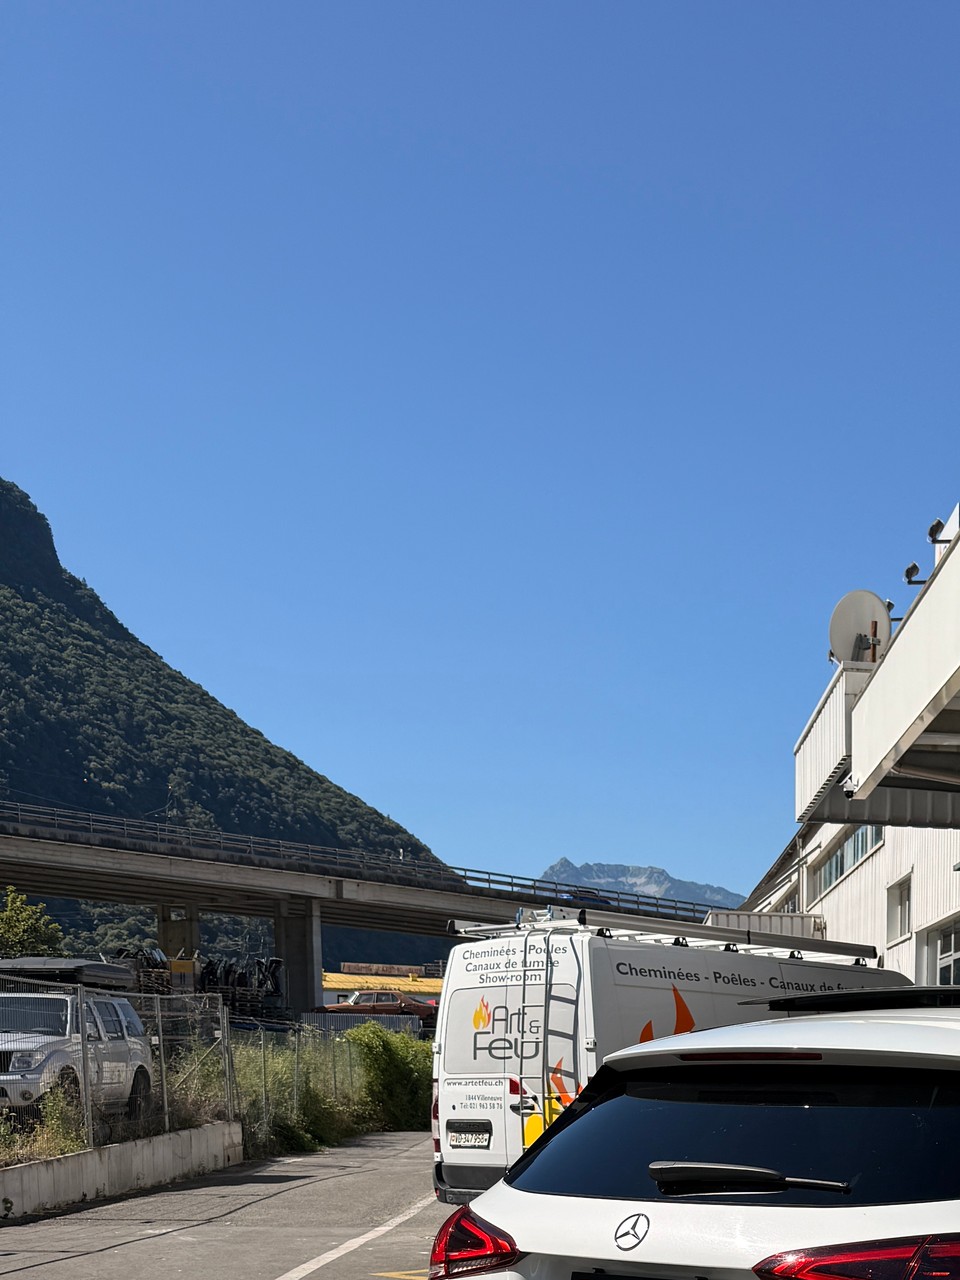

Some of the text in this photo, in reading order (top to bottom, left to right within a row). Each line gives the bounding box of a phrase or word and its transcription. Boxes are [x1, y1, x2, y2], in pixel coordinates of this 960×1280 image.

[462, 946, 517, 960] Cheminées
[465, 960, 501, 972] Canaux
[504, 959, 518, 969] de
[479, 973, 542, 984] Show-room
[616, 962, 701, 982] Cheminées
[713, 971, 757, 987] Poêles
[768, 976, 816, 993] Canaux
[492, 1005, 541, 1035] Art &
[473, 1031, 540, 1061] Feu
